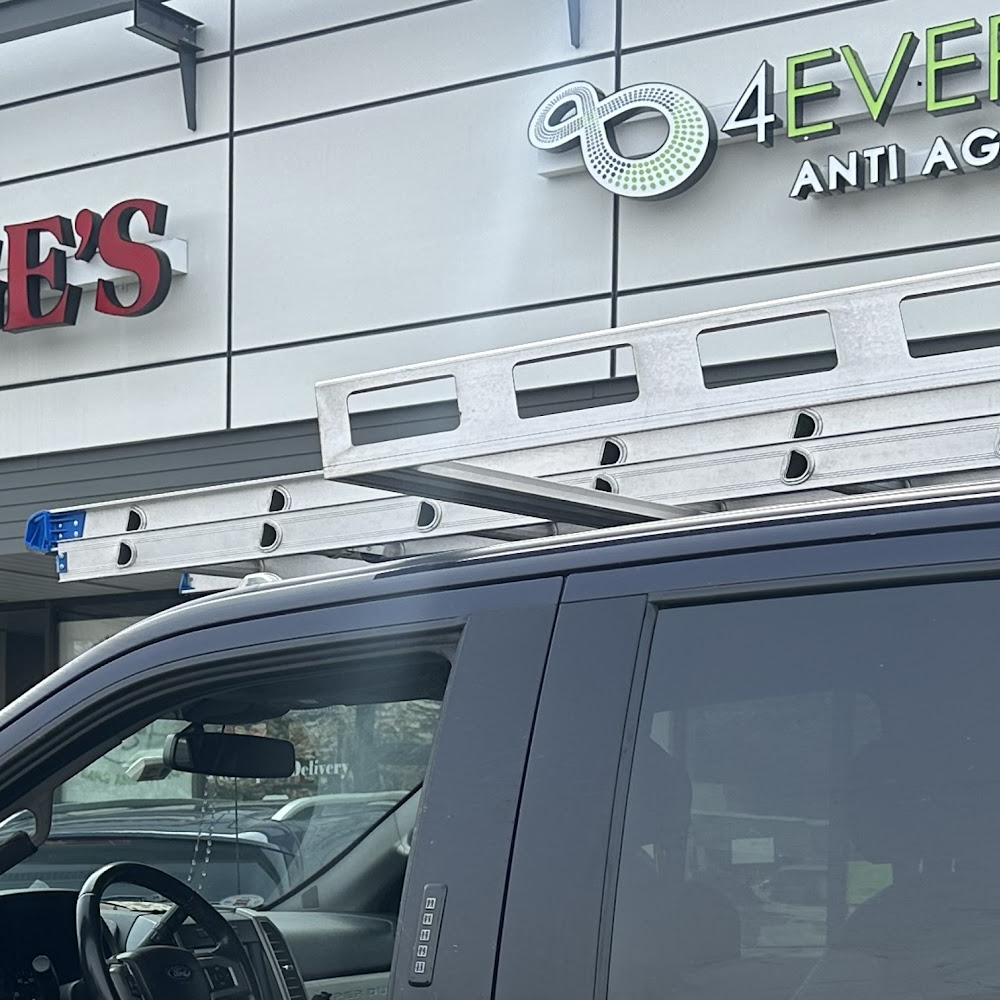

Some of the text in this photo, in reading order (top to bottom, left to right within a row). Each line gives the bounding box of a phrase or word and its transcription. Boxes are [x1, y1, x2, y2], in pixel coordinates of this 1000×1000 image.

[721, 13, 1000, 147] 4EVE
[789, 127, 1000, 200] ANTI AG
